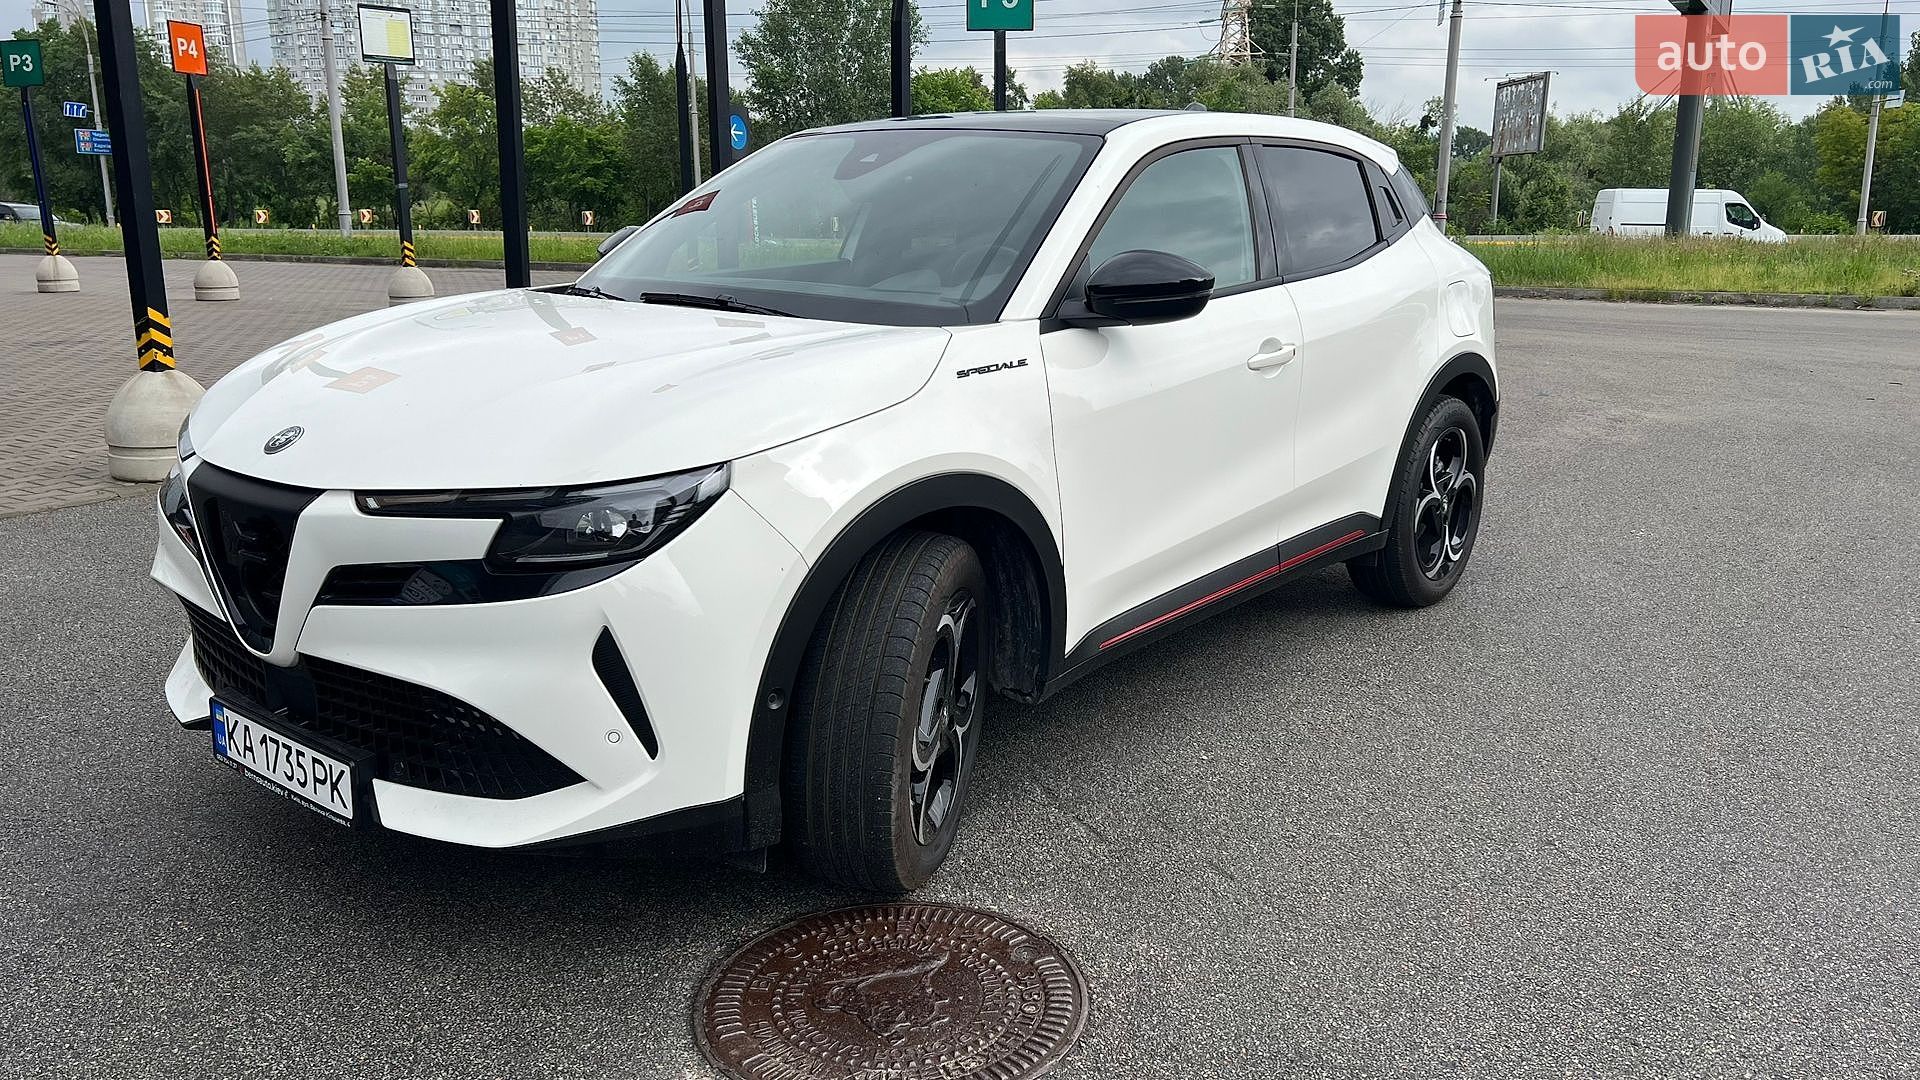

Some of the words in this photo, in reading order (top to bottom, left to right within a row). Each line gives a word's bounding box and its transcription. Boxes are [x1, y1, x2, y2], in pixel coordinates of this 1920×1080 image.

[176, 37, 199, 59] P4
[9, 54, 34, 72] P3
[217, 733, 227, 748] UA
